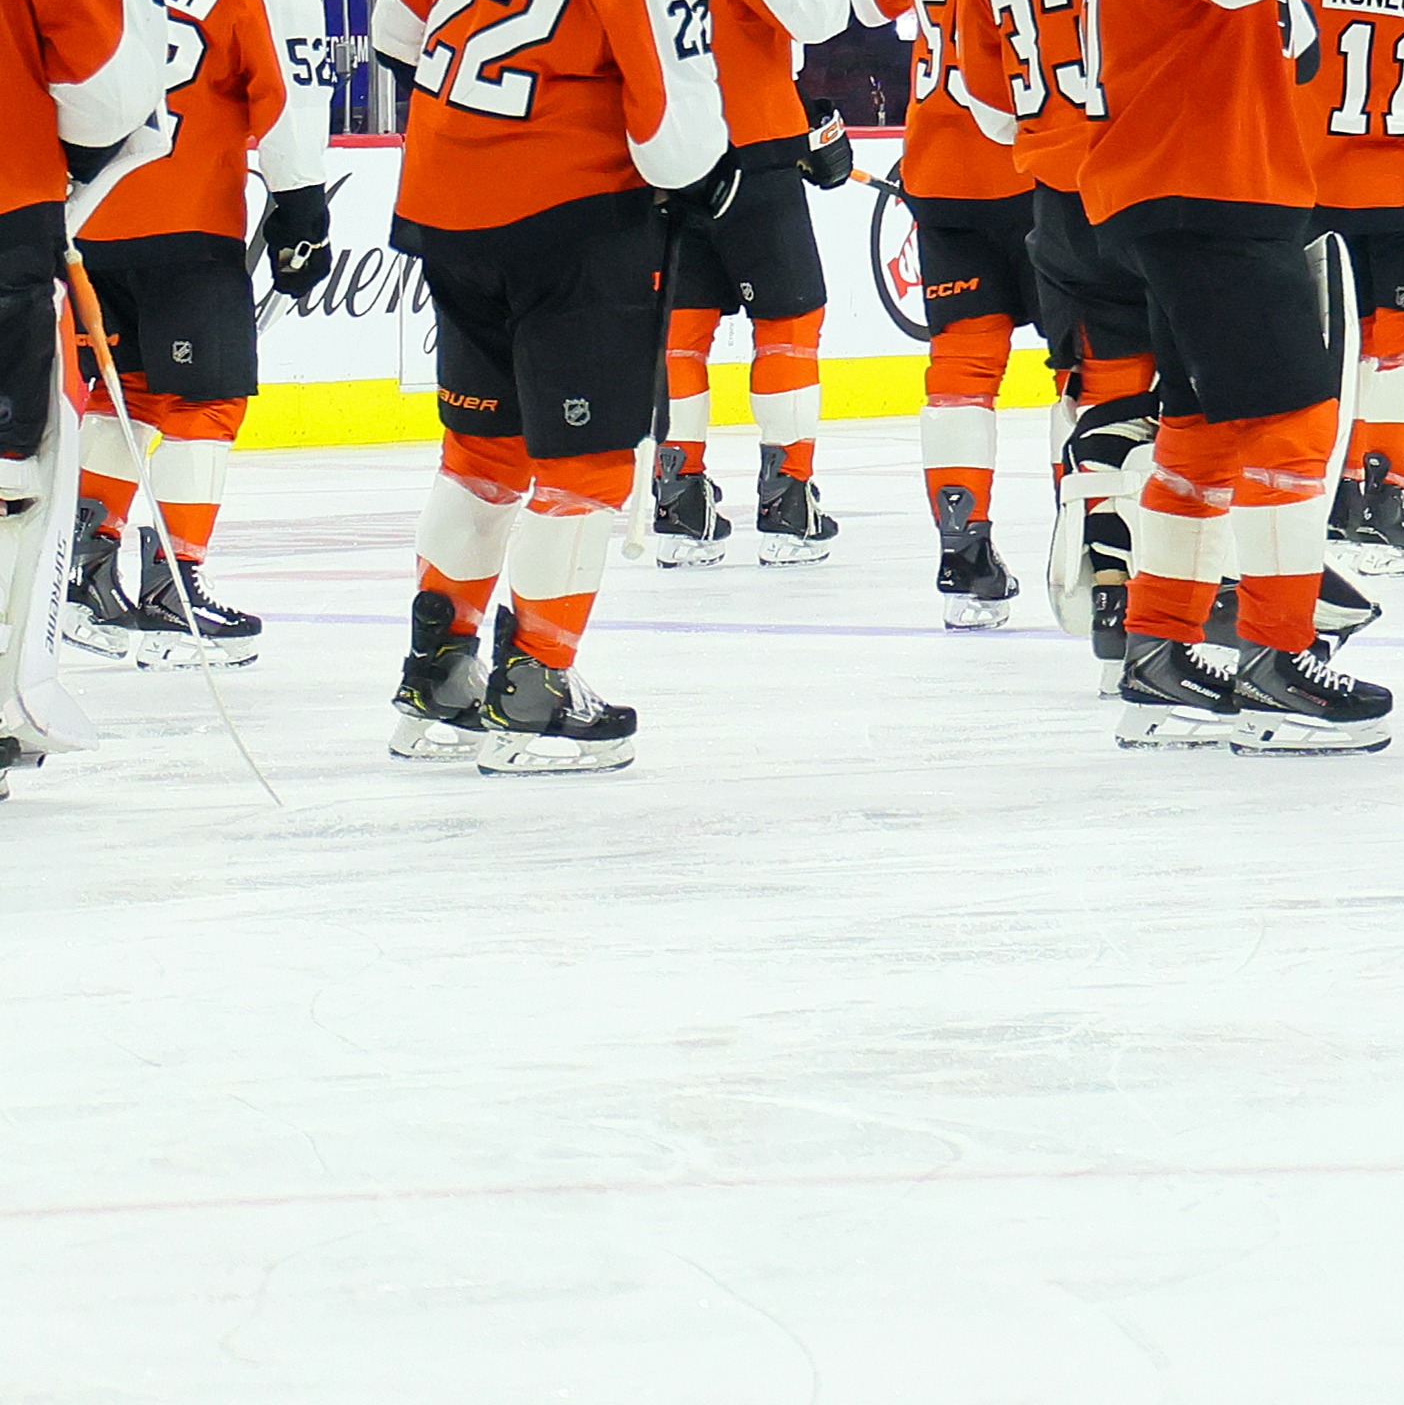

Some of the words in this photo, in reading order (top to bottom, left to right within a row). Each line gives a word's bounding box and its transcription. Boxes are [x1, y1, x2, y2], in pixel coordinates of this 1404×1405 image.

[286, 37, 336, 87] 52
[926, 278, 980, 300] CCM
[438, 387, 498, 412] AUER
